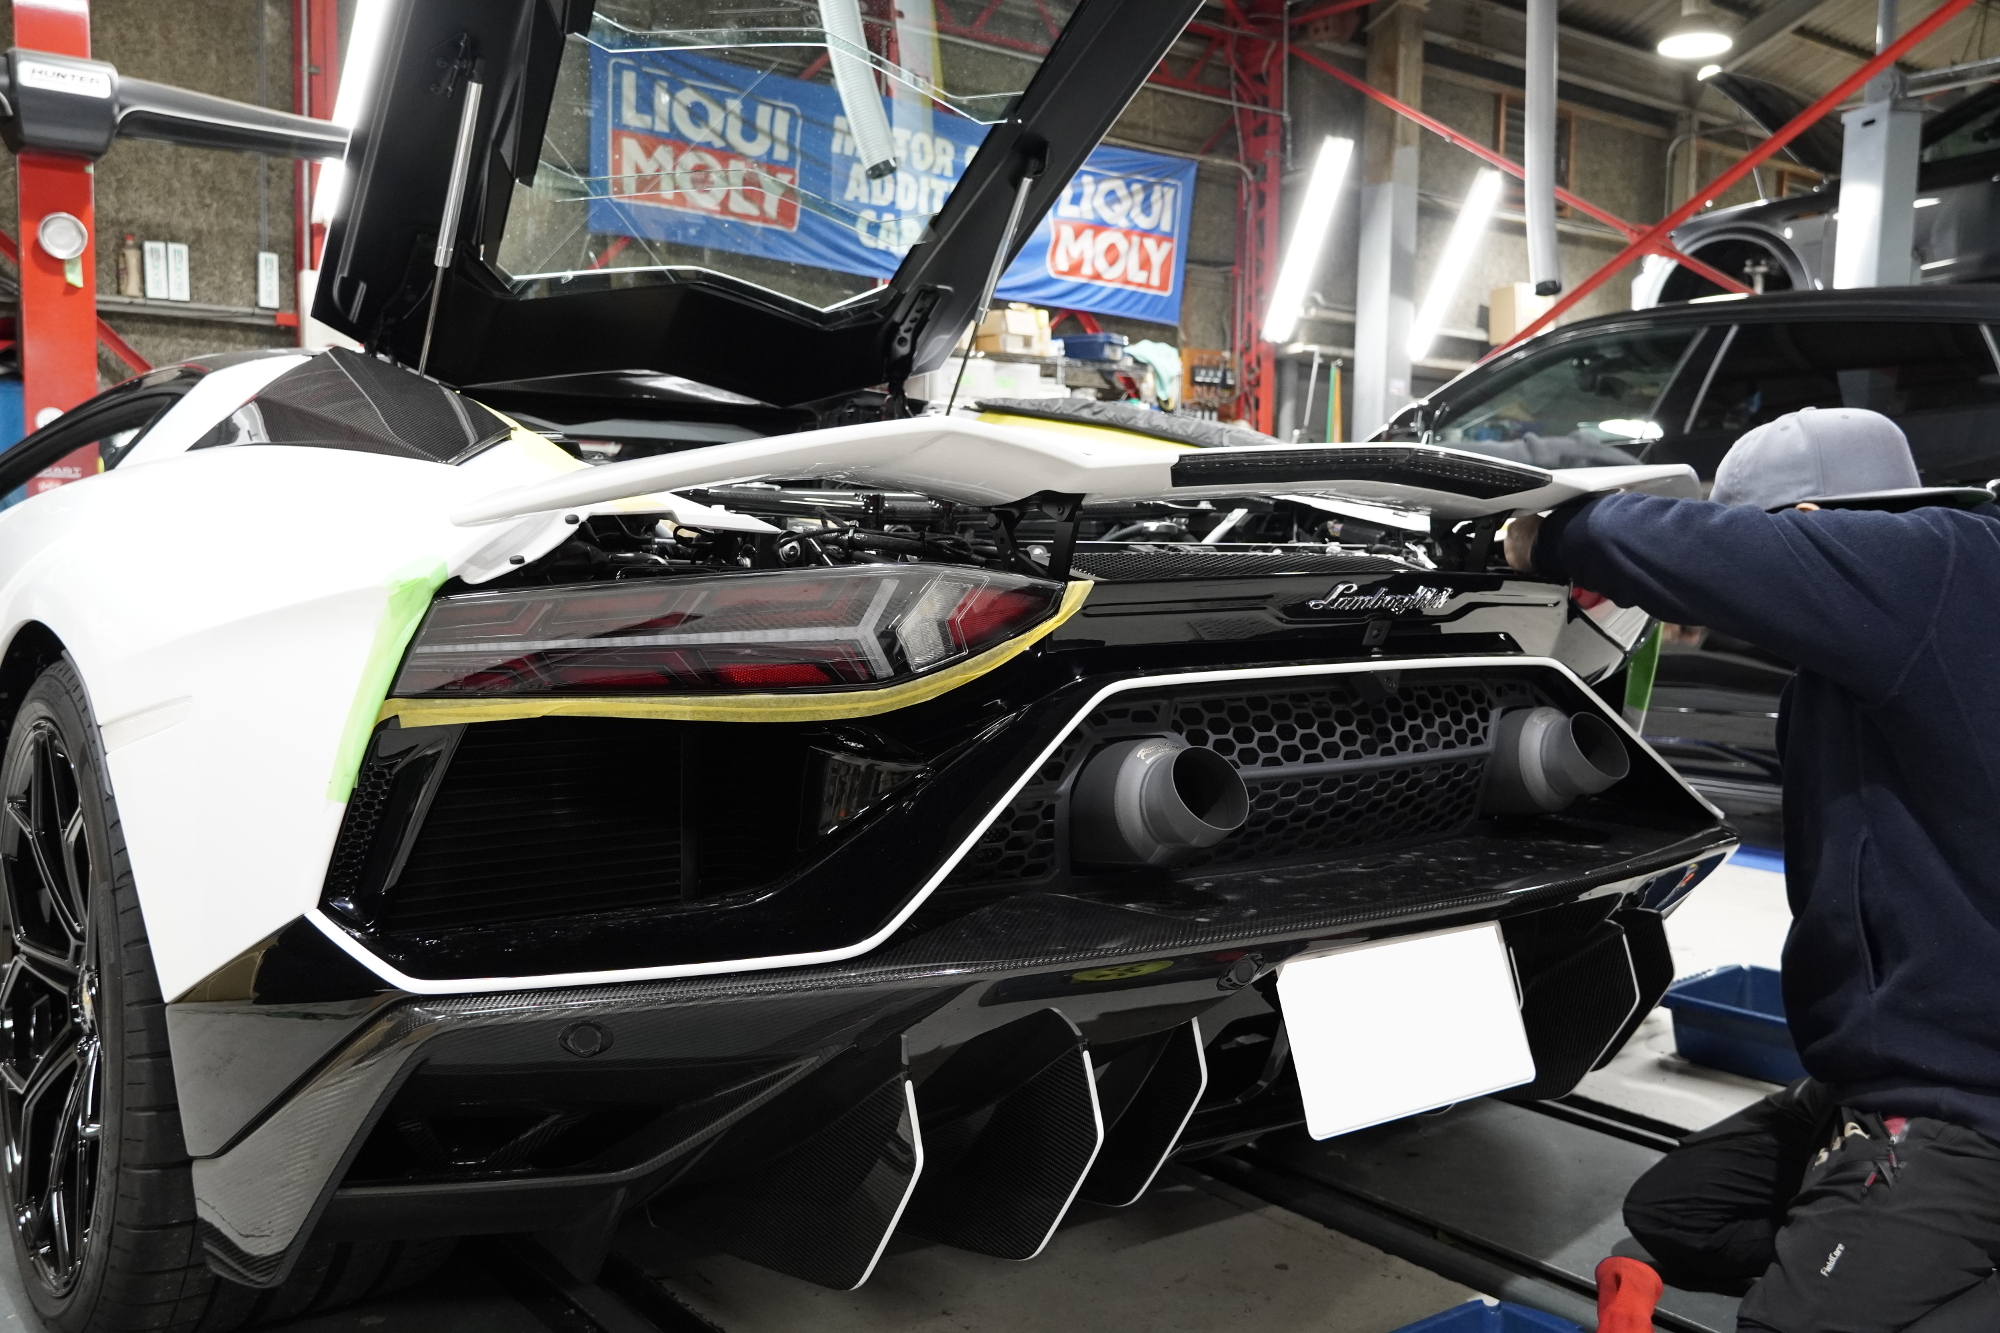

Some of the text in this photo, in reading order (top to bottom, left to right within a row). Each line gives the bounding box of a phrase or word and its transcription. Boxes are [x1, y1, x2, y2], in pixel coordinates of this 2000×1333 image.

[31, 68, 100, 85] HUNTER
[621, 69, 791, 162] LIQUI
[831, 115, 956, 178] MTOR
[620, 137, 794, 221] MOLY
[844, 162, 957, 216] ADDIT
[1057, 174, 1176, 233] LIQUI
[1055, 224, 1173, 287] MOLY
